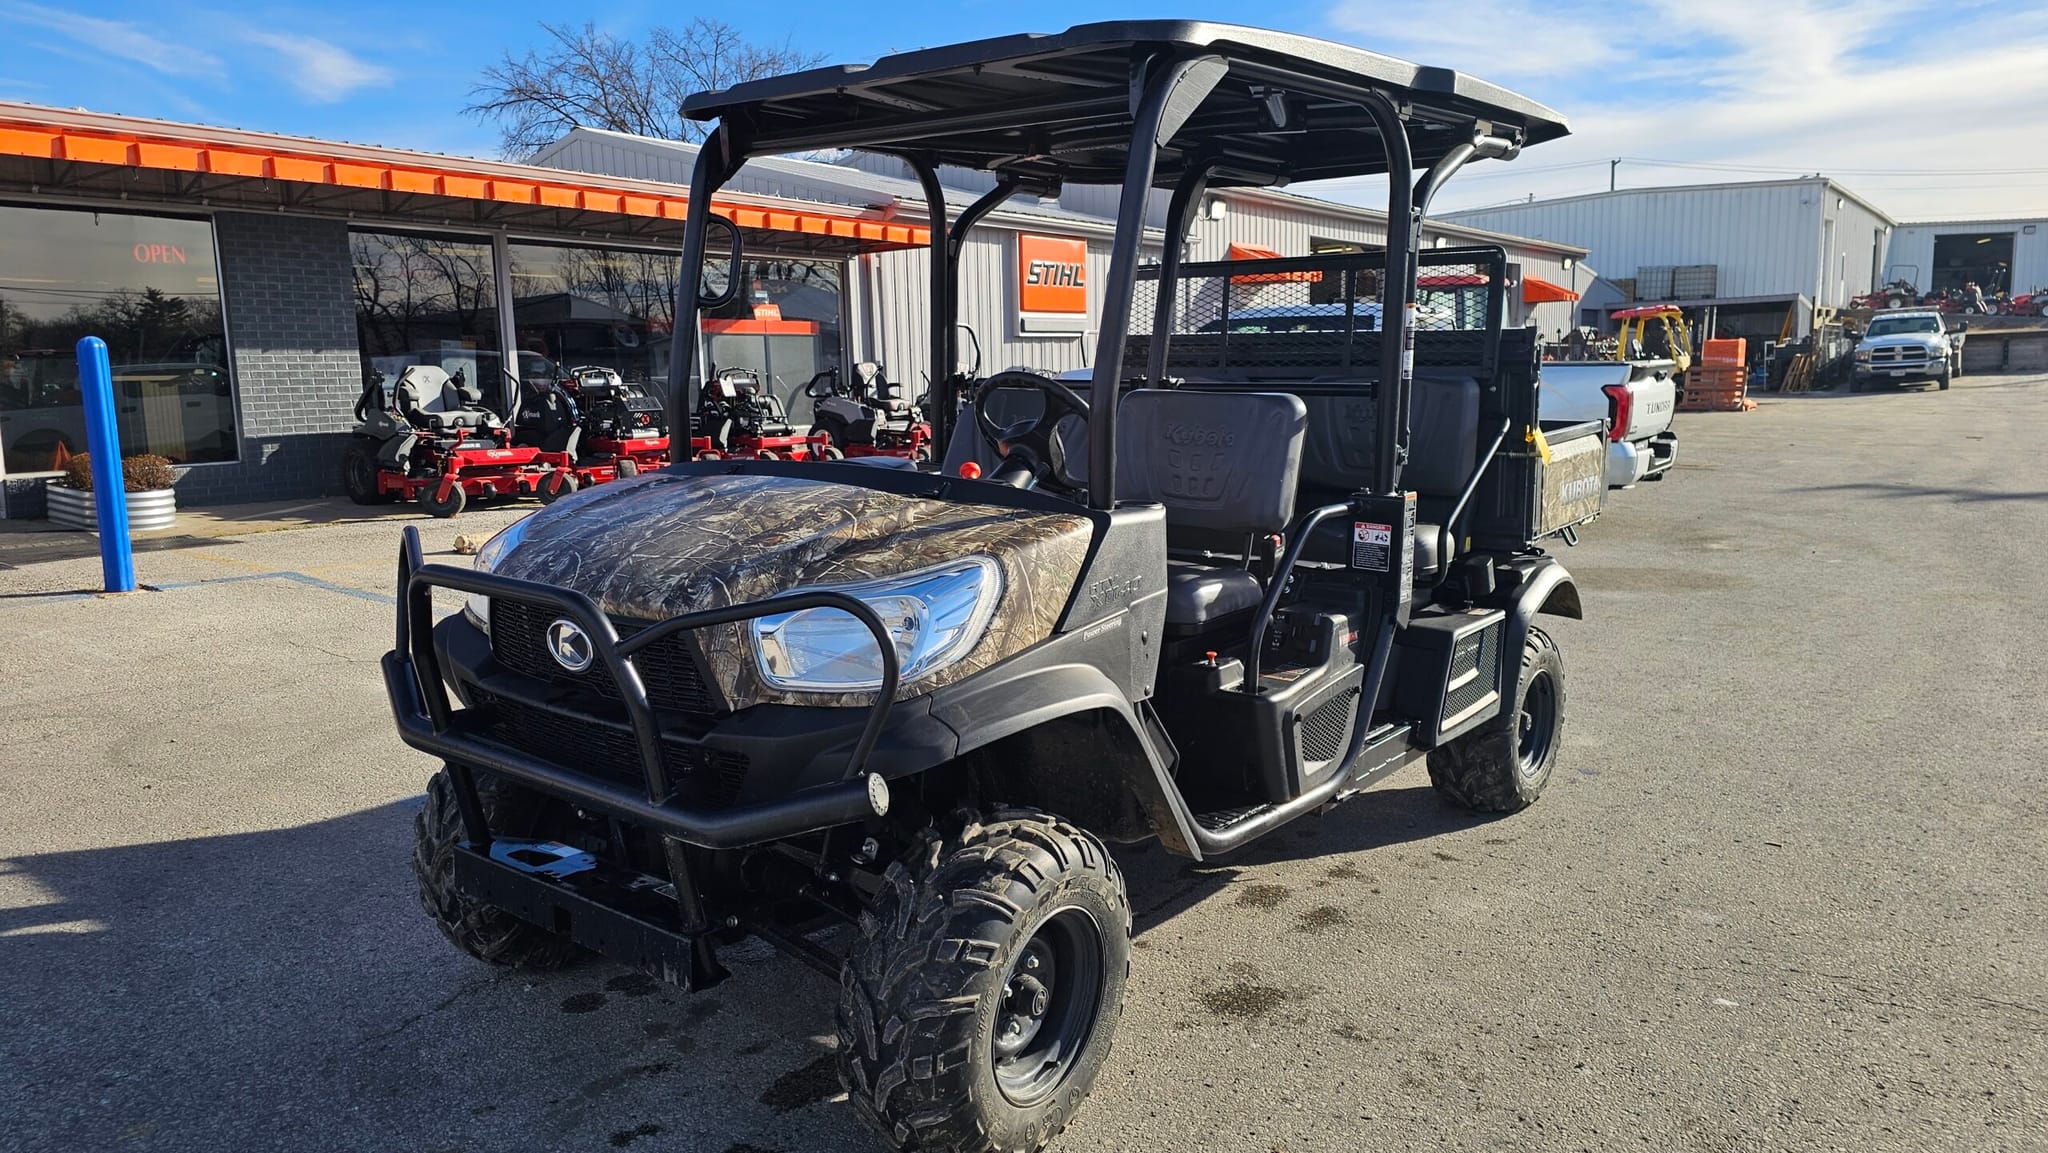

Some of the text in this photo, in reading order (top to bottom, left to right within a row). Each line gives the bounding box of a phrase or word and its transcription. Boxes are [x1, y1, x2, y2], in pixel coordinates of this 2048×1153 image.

[133, 243, 187, 264] OPEN
[1027, 260, 1086, 288] STIHL
[755, 308, 779, 317] STIHL
[1560, 474, 1598, 504] KUBOTA
